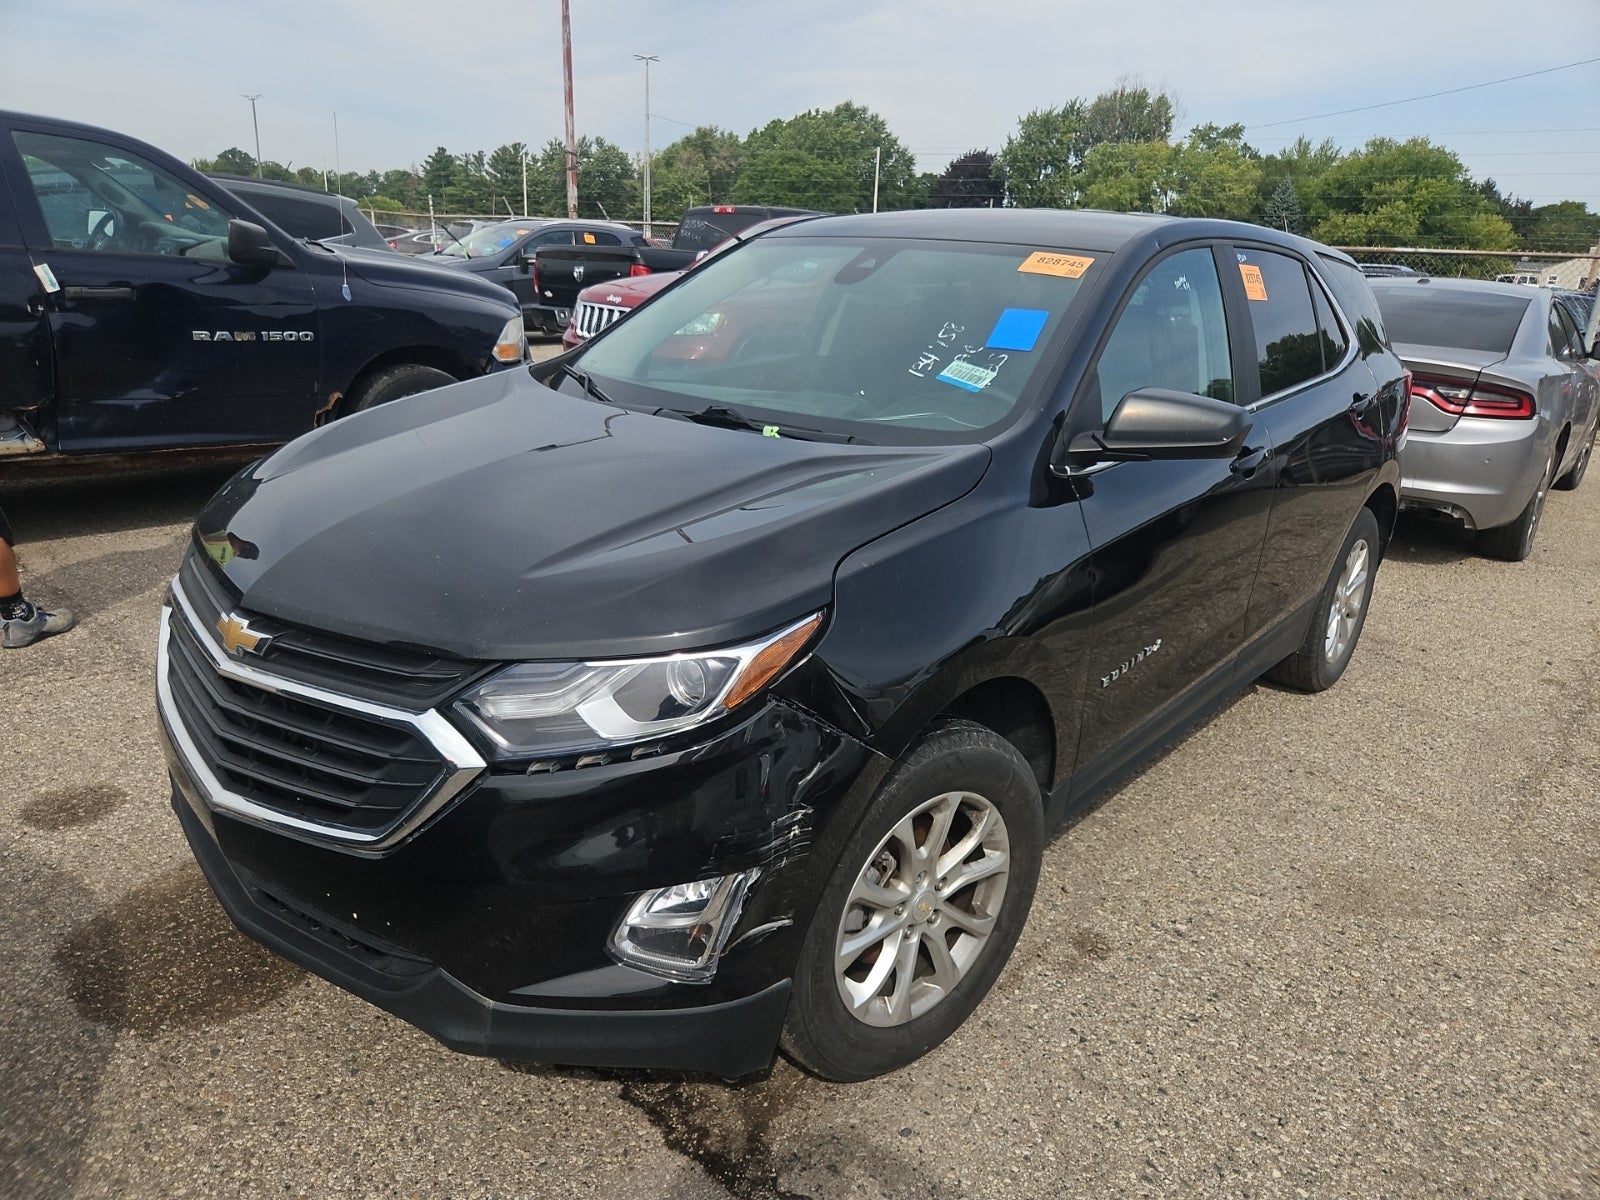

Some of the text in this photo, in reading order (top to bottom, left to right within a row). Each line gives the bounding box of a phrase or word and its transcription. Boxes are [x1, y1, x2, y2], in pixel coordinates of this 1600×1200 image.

[1036, 256, 1085, 269] 828745
[606, 294, 623, 304] Jeep
[192, 330, 315, 341] RAM 1500
